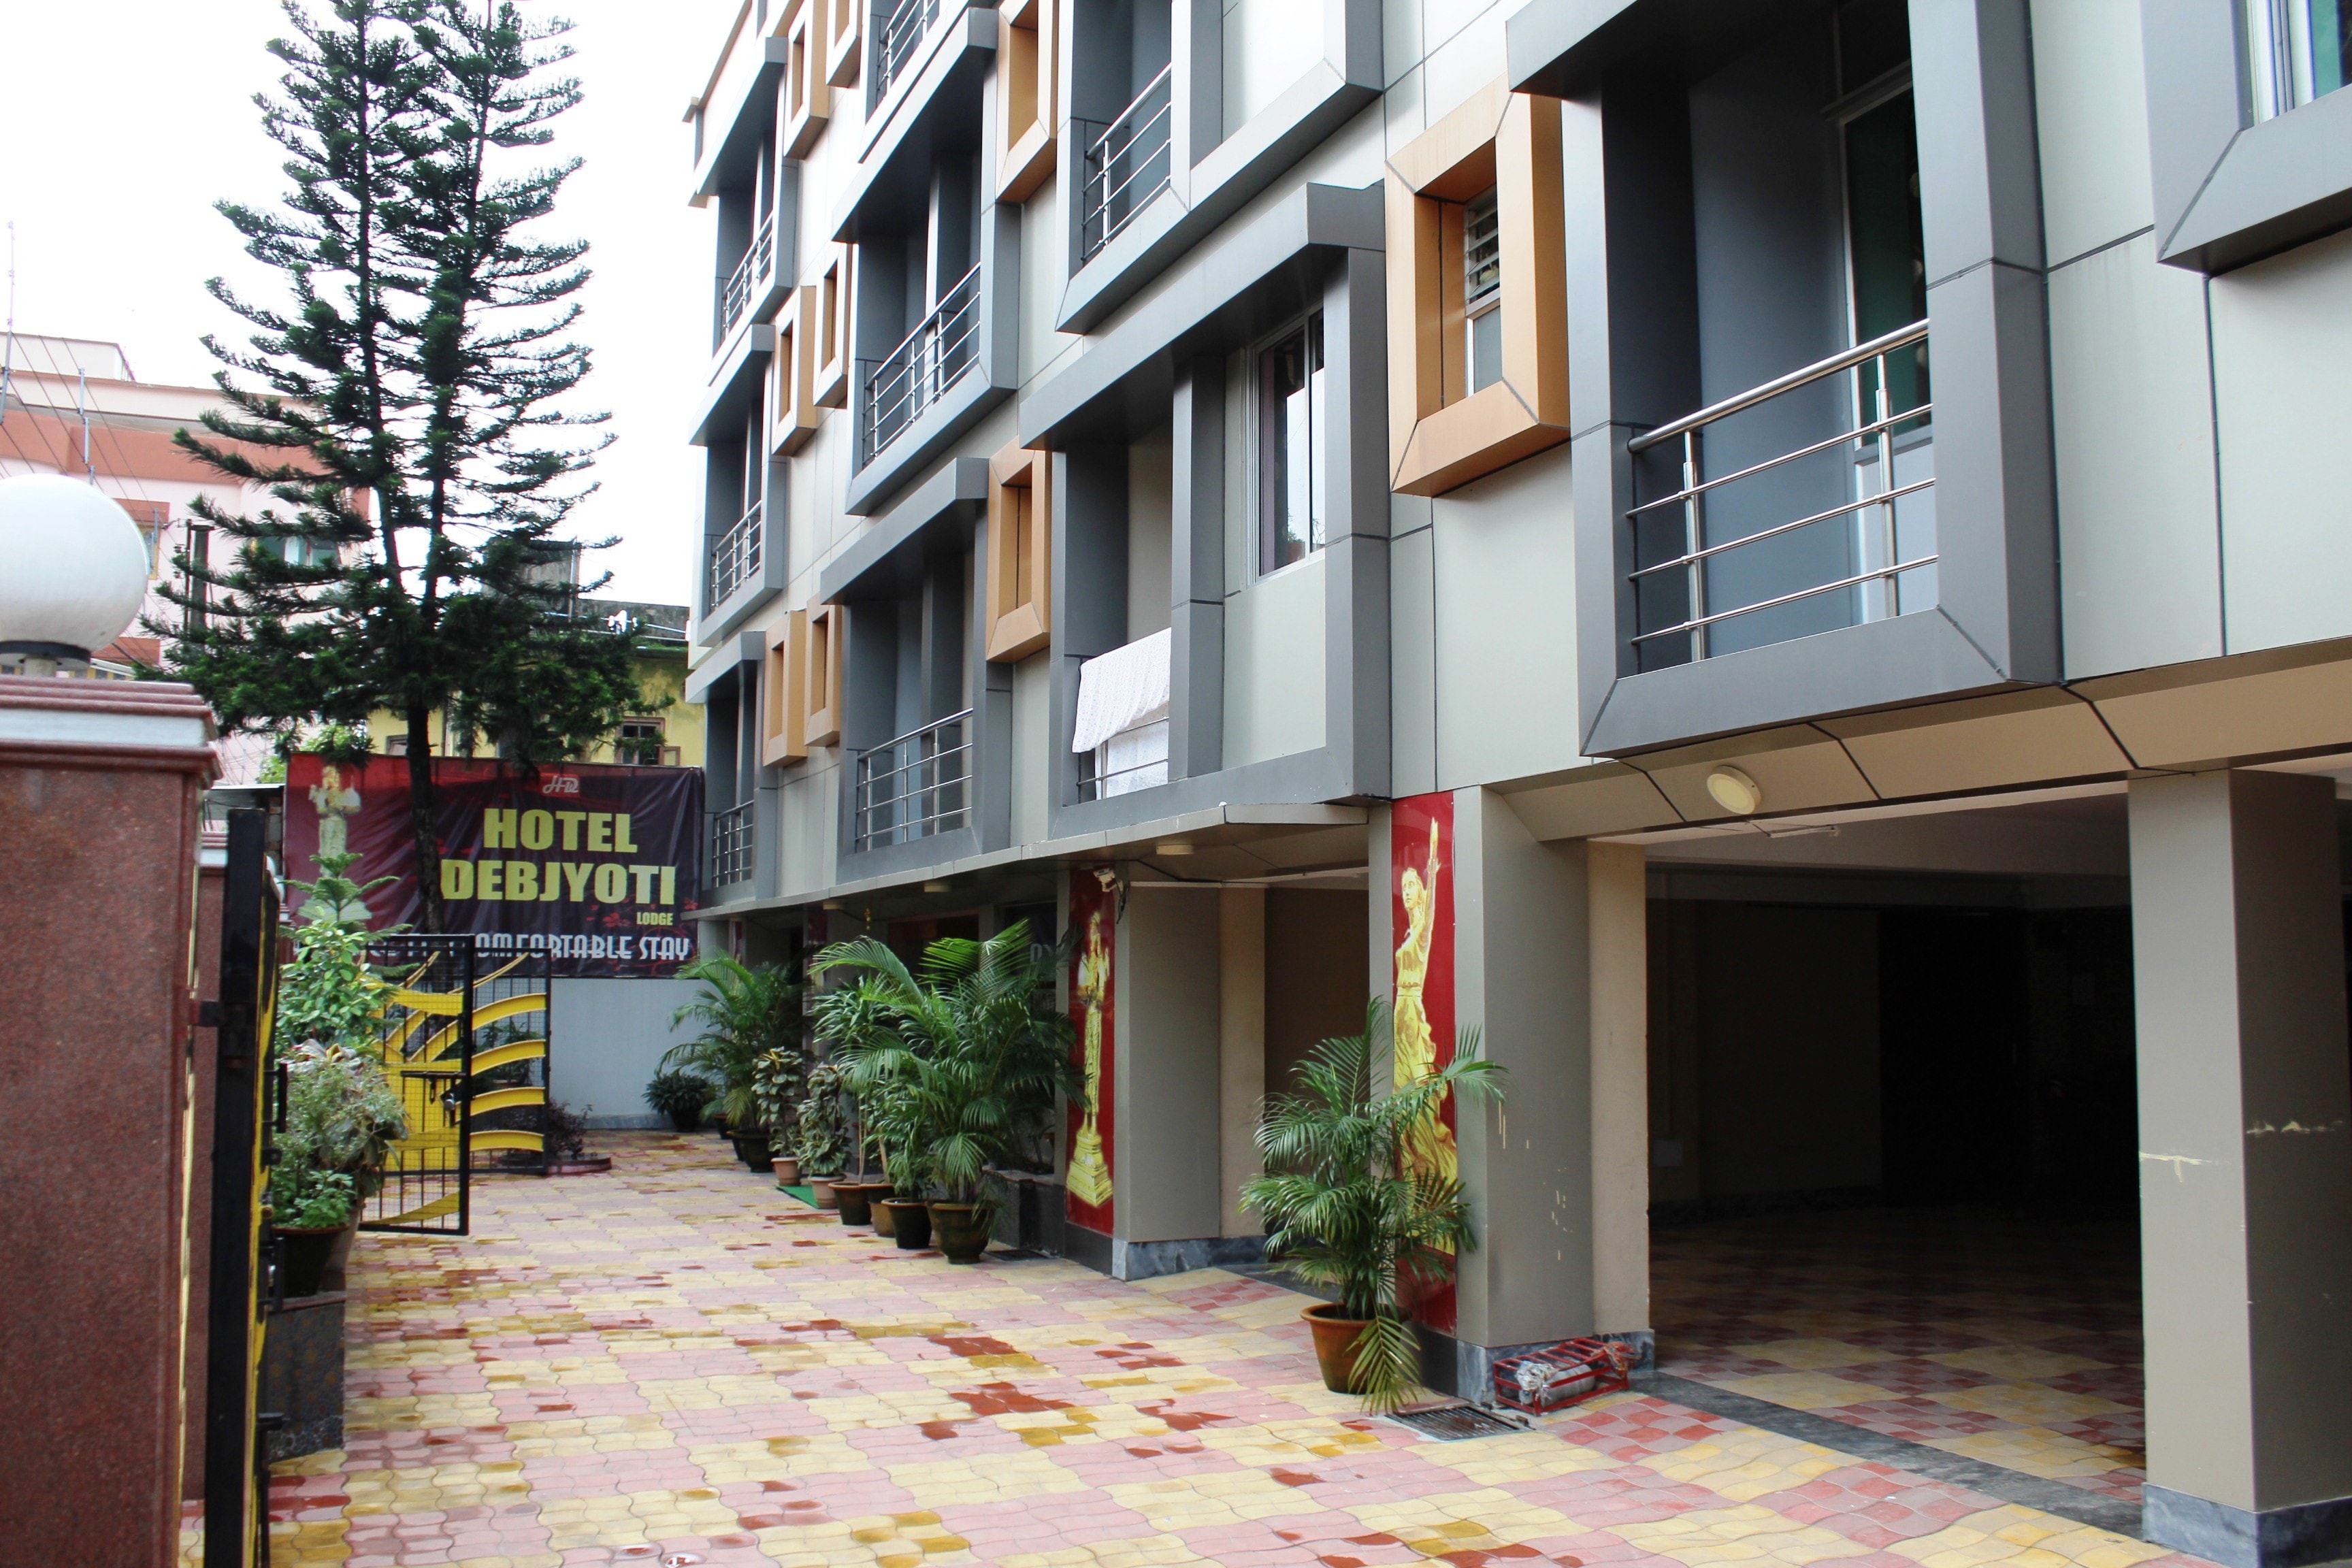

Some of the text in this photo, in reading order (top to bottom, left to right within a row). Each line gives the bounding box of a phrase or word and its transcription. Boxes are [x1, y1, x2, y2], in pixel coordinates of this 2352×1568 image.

[484, 808, 638, 853] HOTEL
[440, 860, 675, 904] DEBJYOTI
[637, 912, 673, 926] LODGE
[462, 933, 632, 959] OMFORTABLE
[639, 936, 689, 961] STAY
